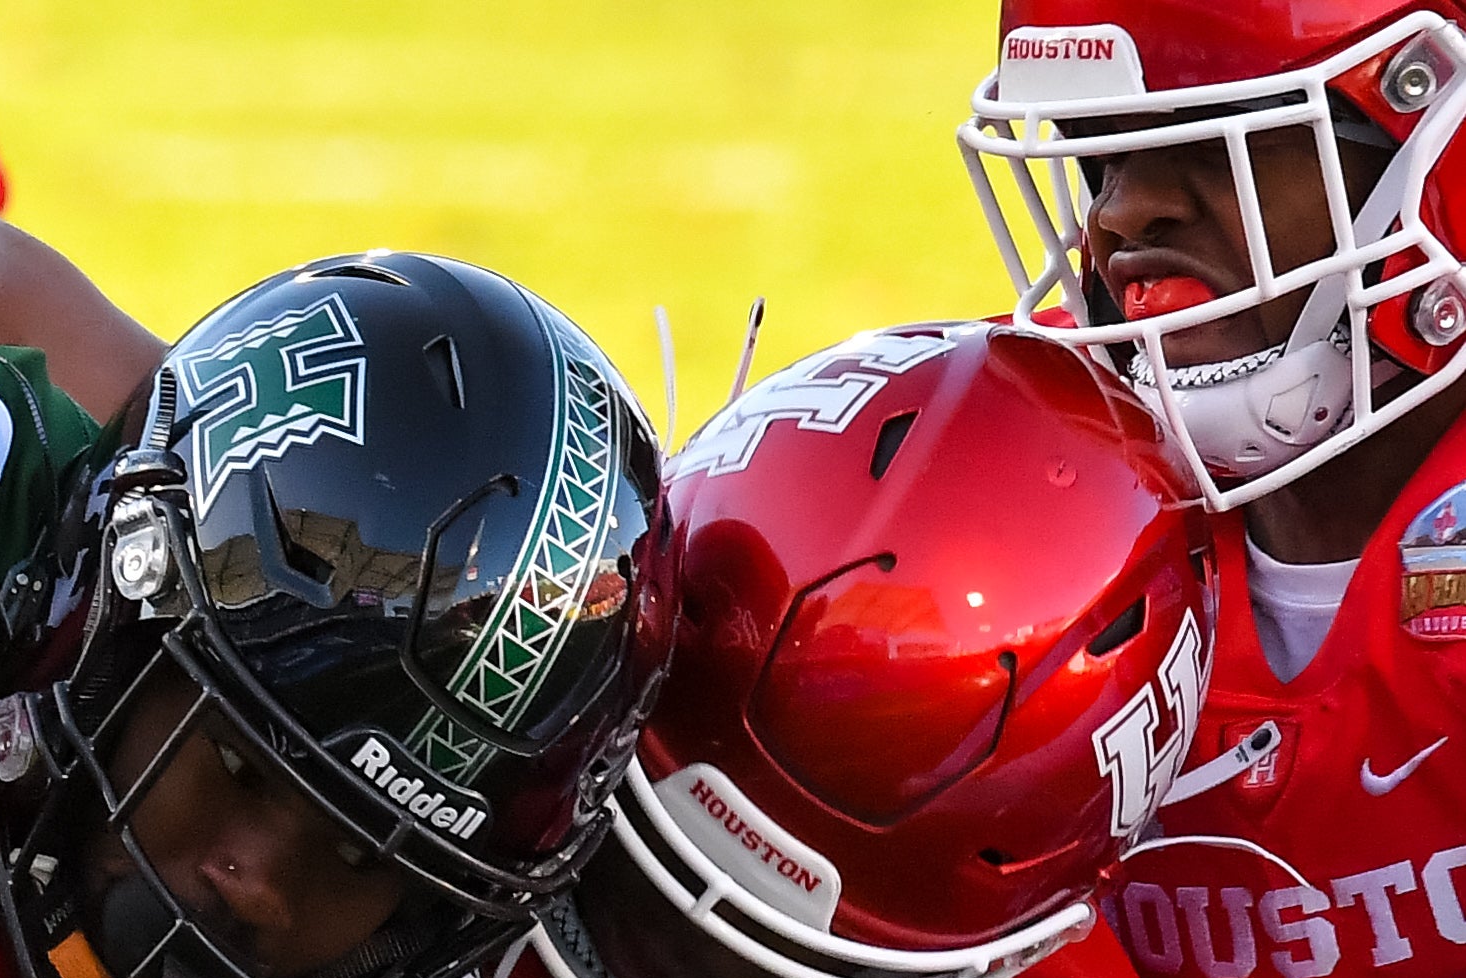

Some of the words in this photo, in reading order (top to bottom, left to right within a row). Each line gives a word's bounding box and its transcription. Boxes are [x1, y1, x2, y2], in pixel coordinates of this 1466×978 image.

[1007, 38, 1114, 60] HOUSTON
[350, 737, 487, 840] Riddell
[689, 779, 822, 892] HOUSTON
